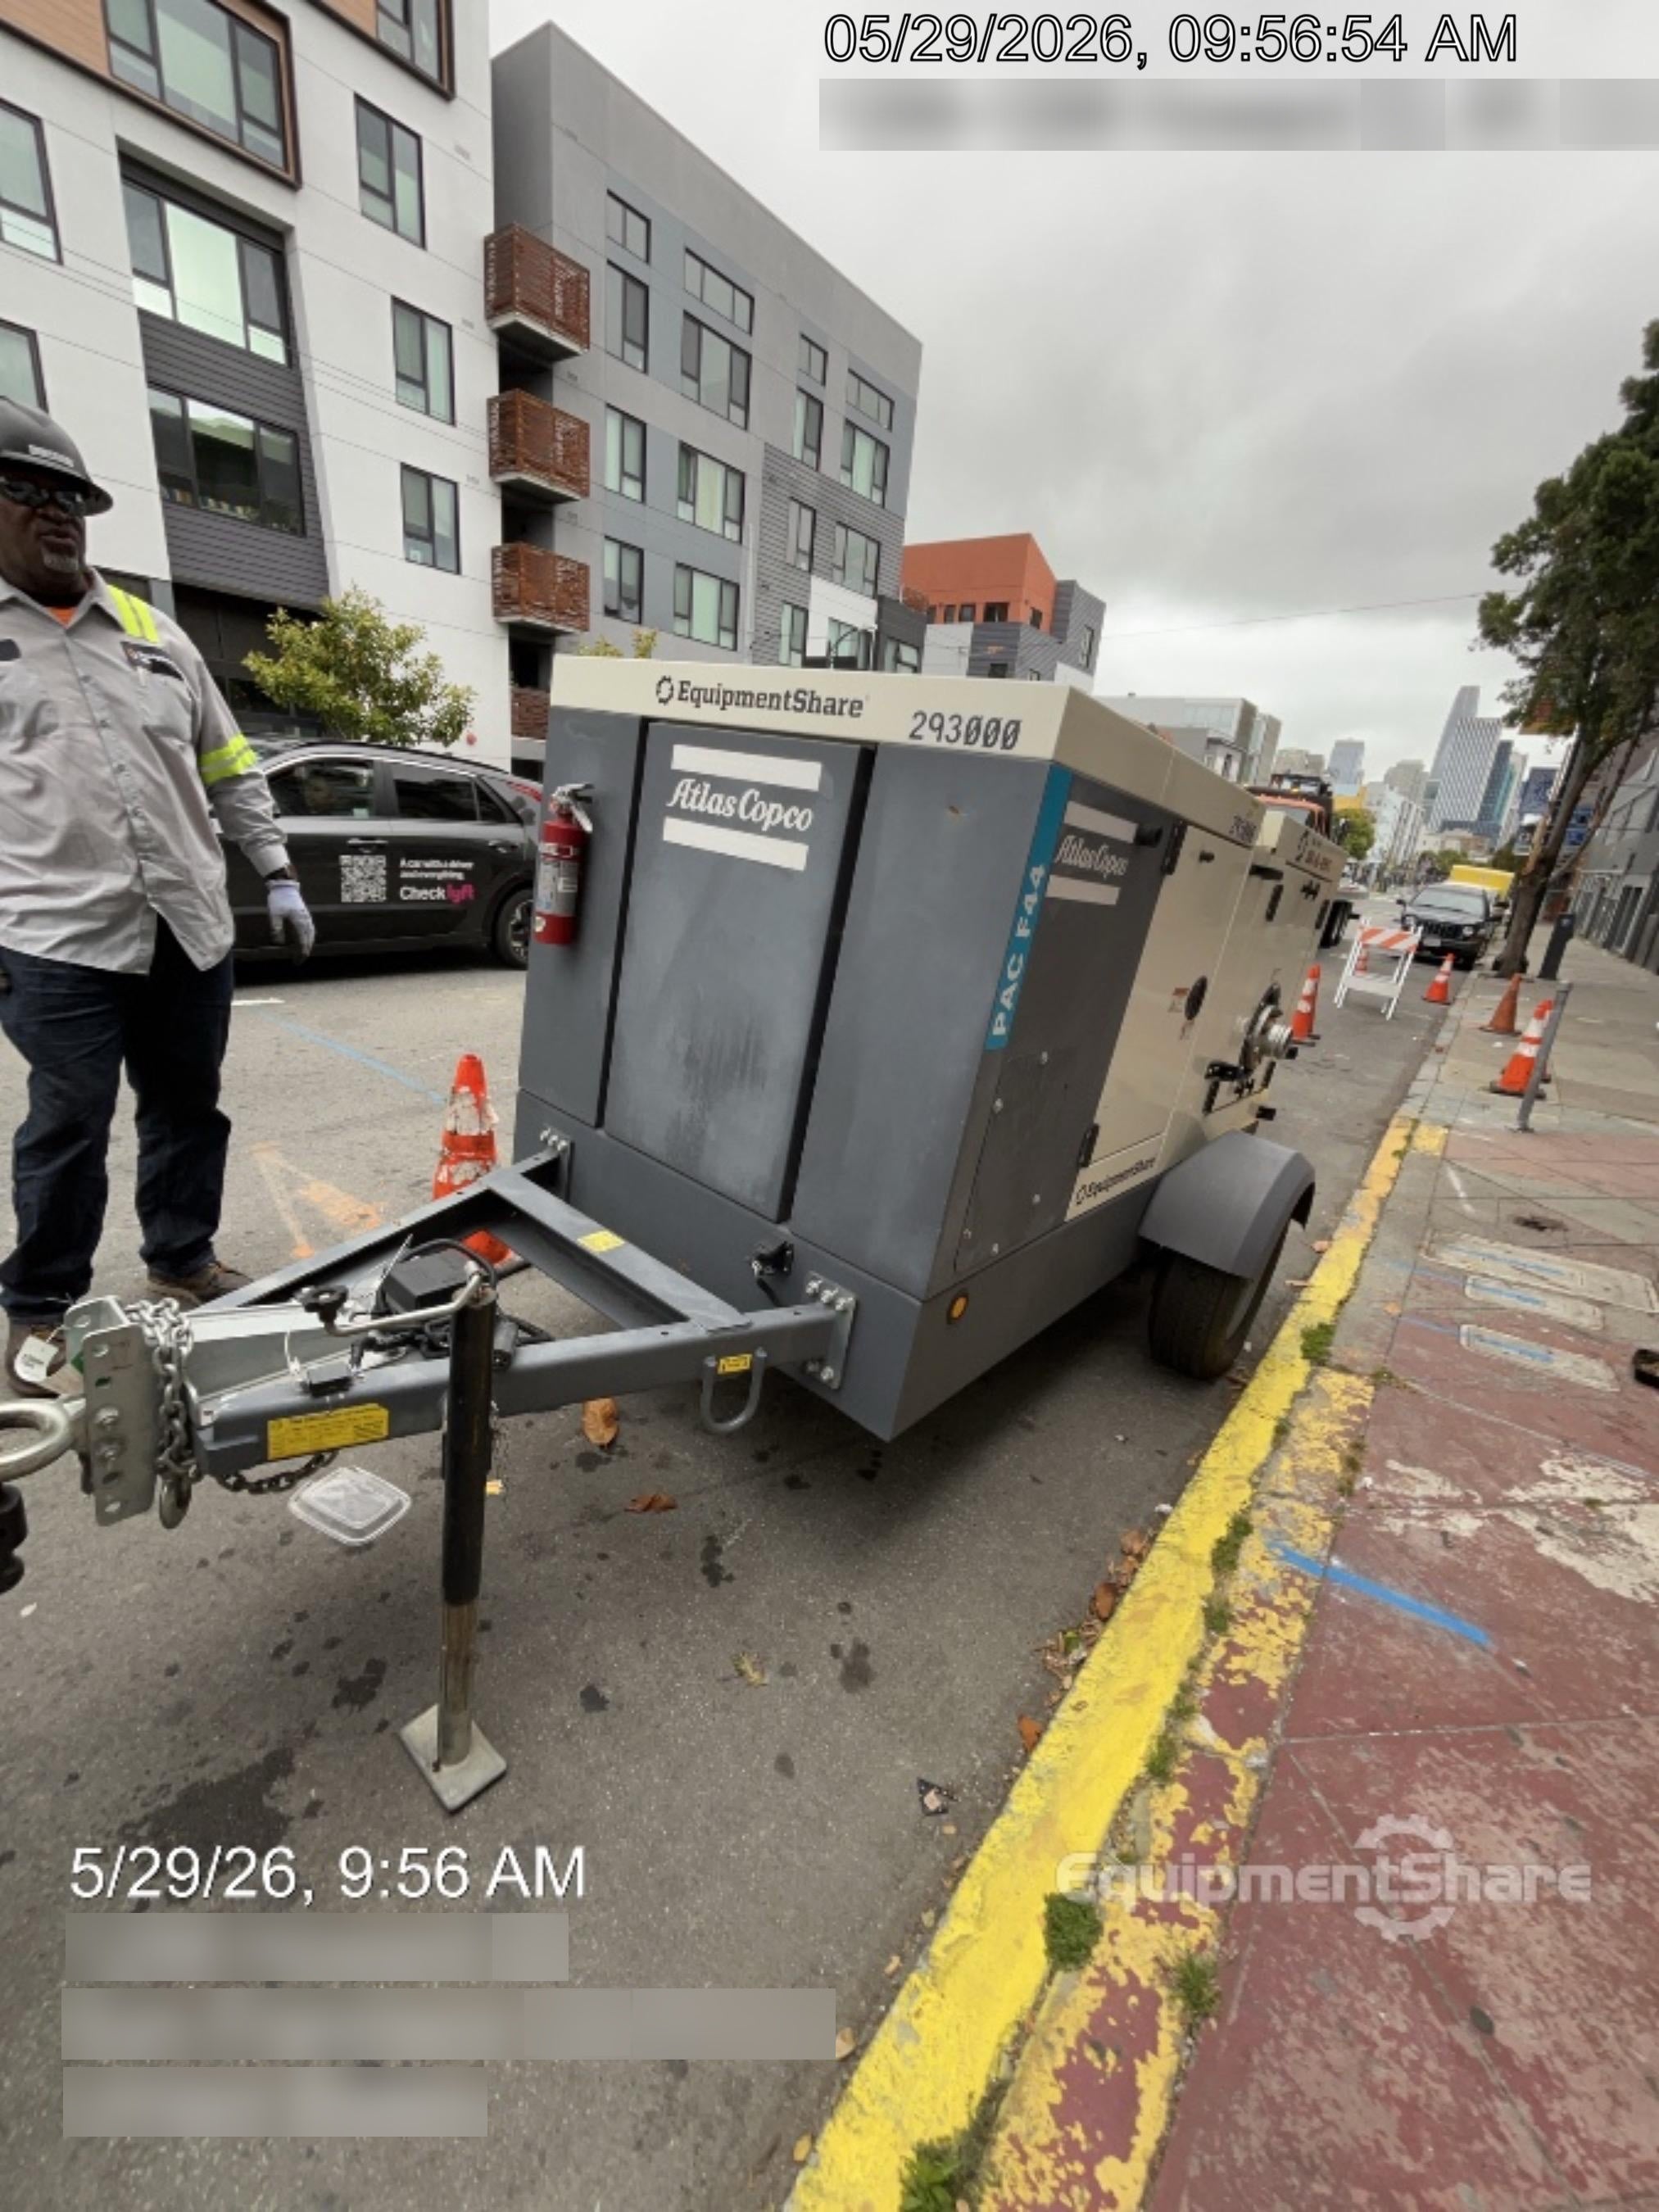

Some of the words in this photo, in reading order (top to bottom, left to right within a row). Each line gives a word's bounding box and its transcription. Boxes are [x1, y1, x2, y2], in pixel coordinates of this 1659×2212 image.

[677, 679, 864, 719] EquipmentShare
[909, 709, 1022, 751] 293000
[665, 777, 737, 818] Atlas
[738, 787, 814, 832] Copco
[400, 886, 446, 900] Check
[992, 952, 1024, 1036] PAC
[1015, 864, 1045, 938] F44
